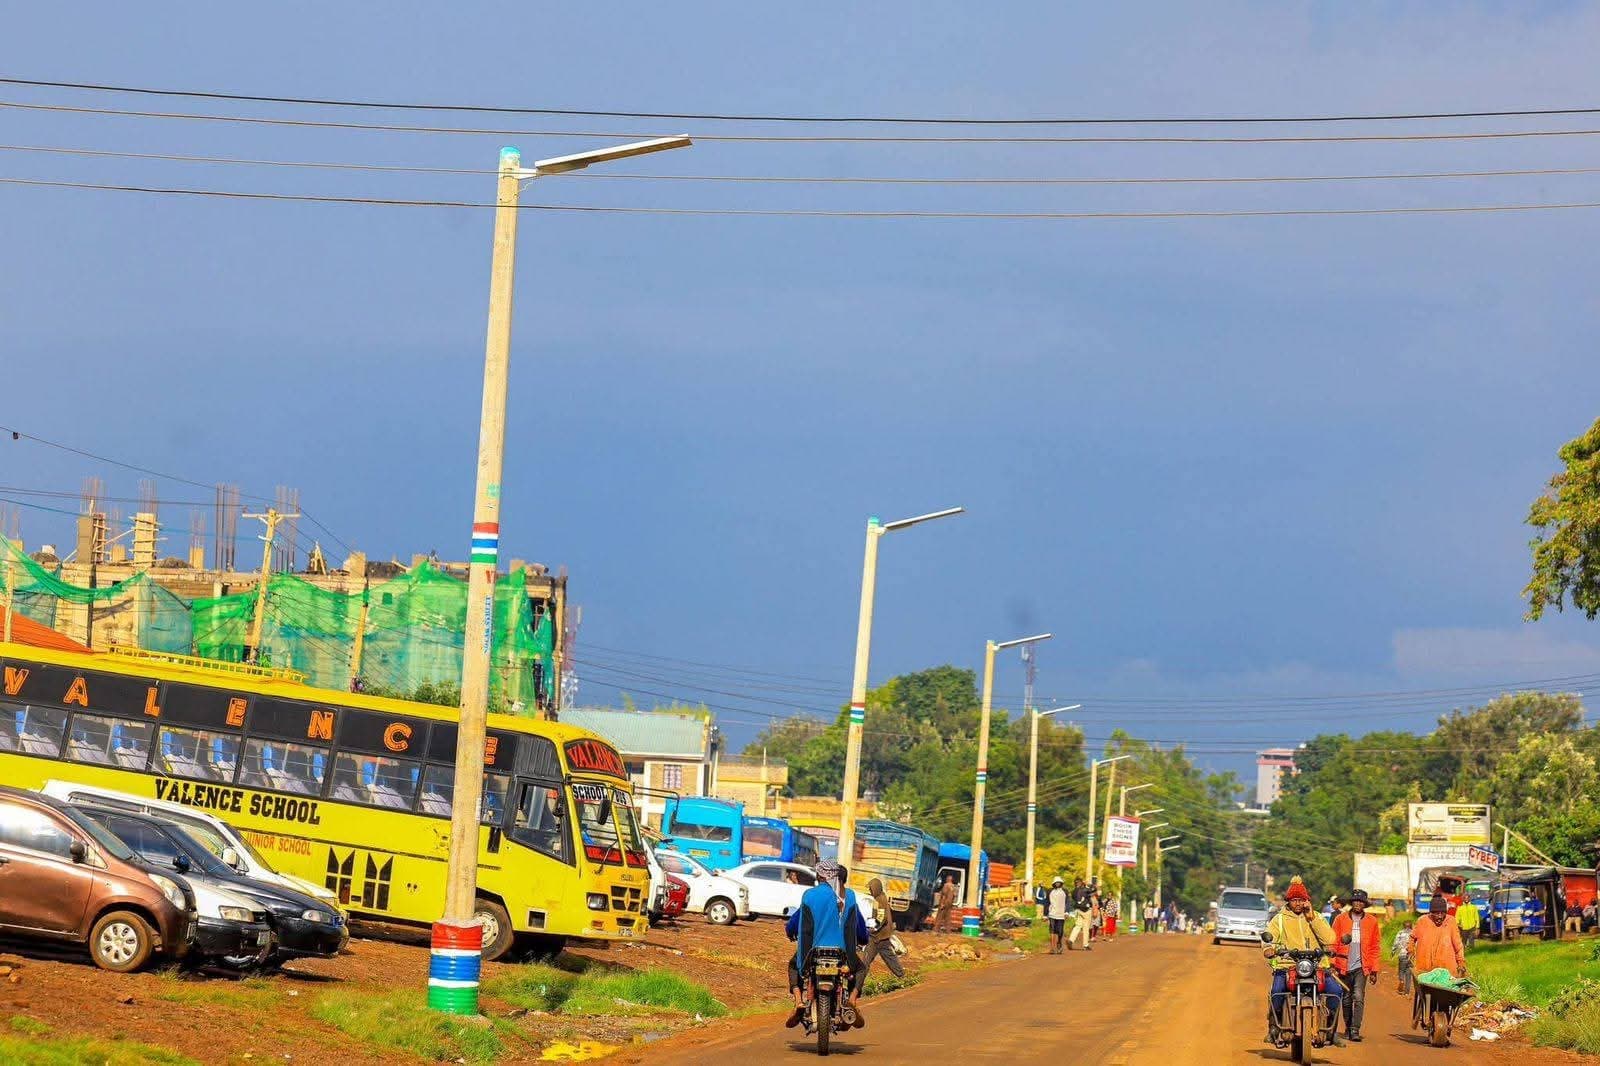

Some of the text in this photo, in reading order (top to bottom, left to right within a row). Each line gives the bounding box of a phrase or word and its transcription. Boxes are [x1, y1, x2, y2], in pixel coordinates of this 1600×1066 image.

[155, 778, 321, 826] VALENCE SCHOOL
[572, 785, 608, 801] SCHOOL
[278, 837, 312, 857] SCHOOL
[1469, 847, 1497, 867] CYBER
